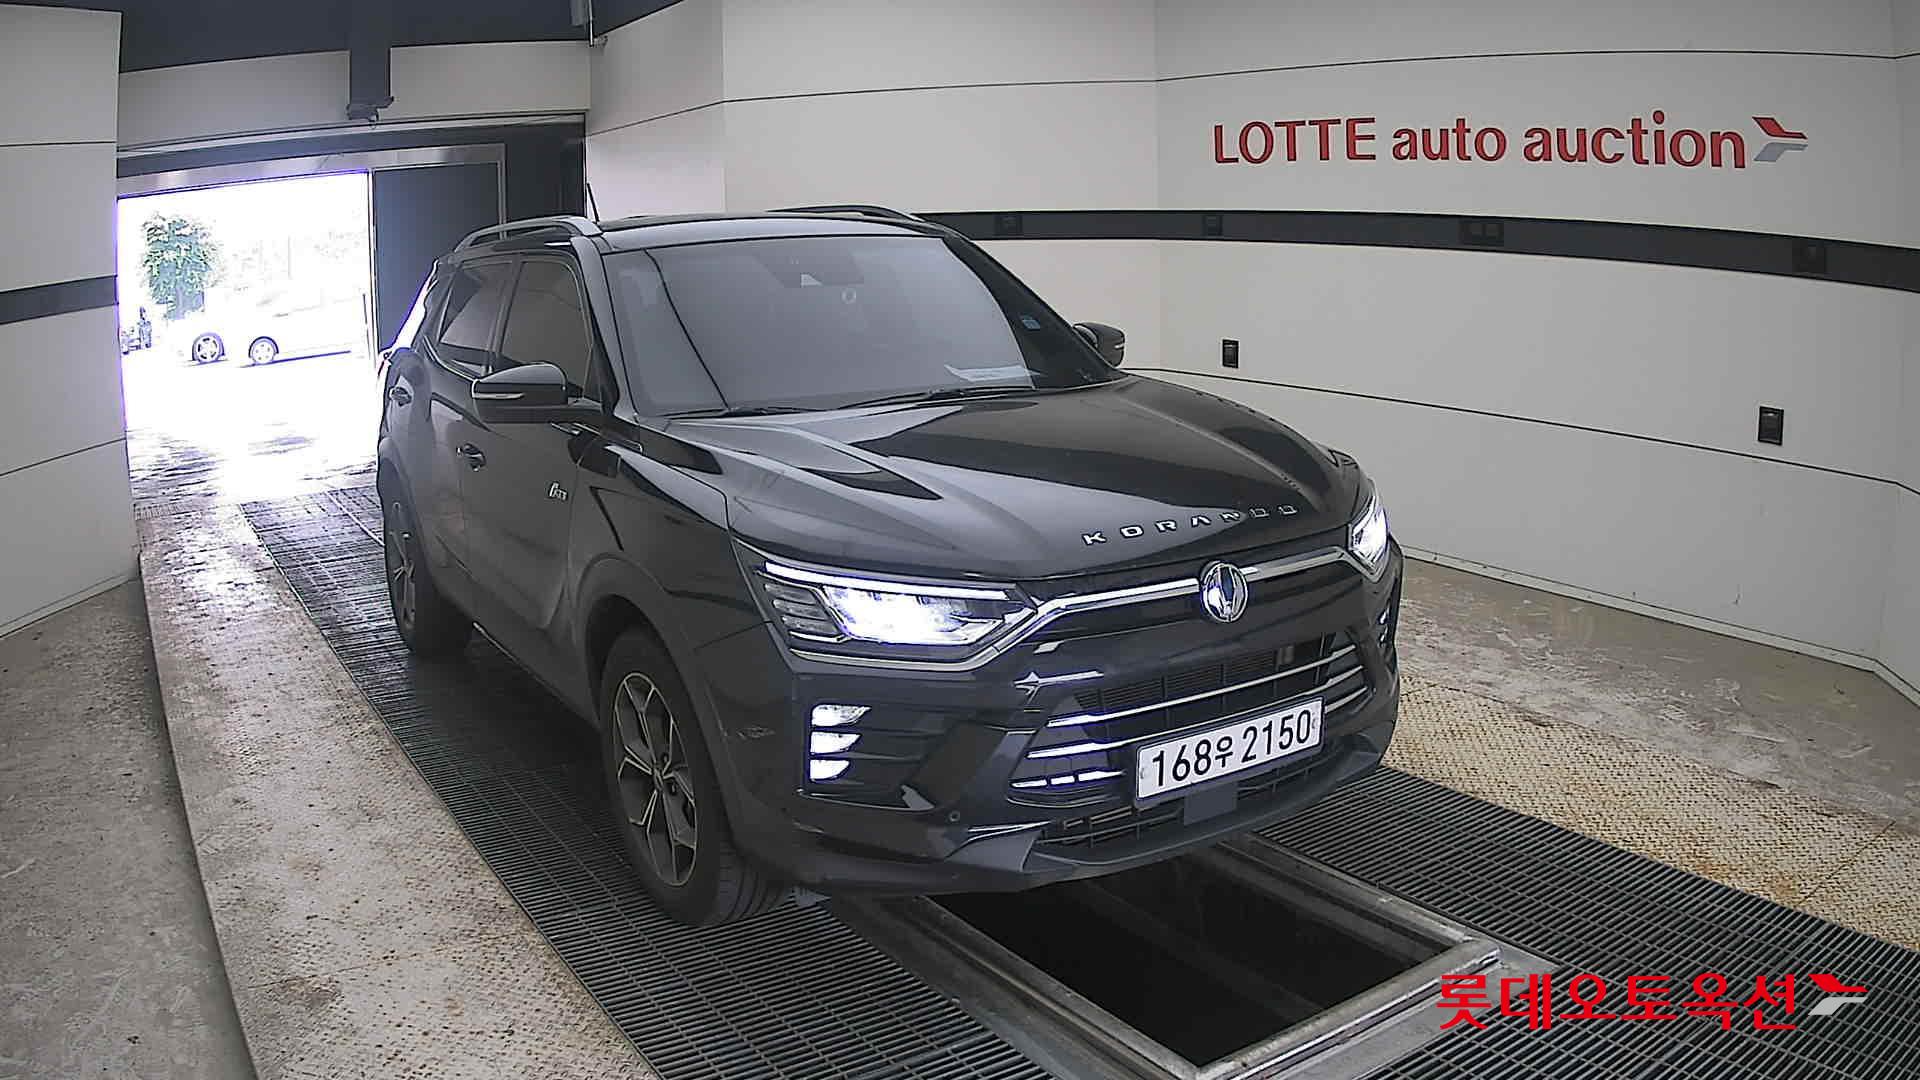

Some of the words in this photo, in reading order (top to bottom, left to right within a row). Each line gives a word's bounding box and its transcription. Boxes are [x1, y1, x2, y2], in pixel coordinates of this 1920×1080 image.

[1212, 116, 1377, 165] LOTTE
[1392, 117, 1507, 161] auto
[1523, 109, 1747, 169] auction
[1081, 503, 1298, 545] KORANDO
[1240, 708, 1312, 764] 2150
